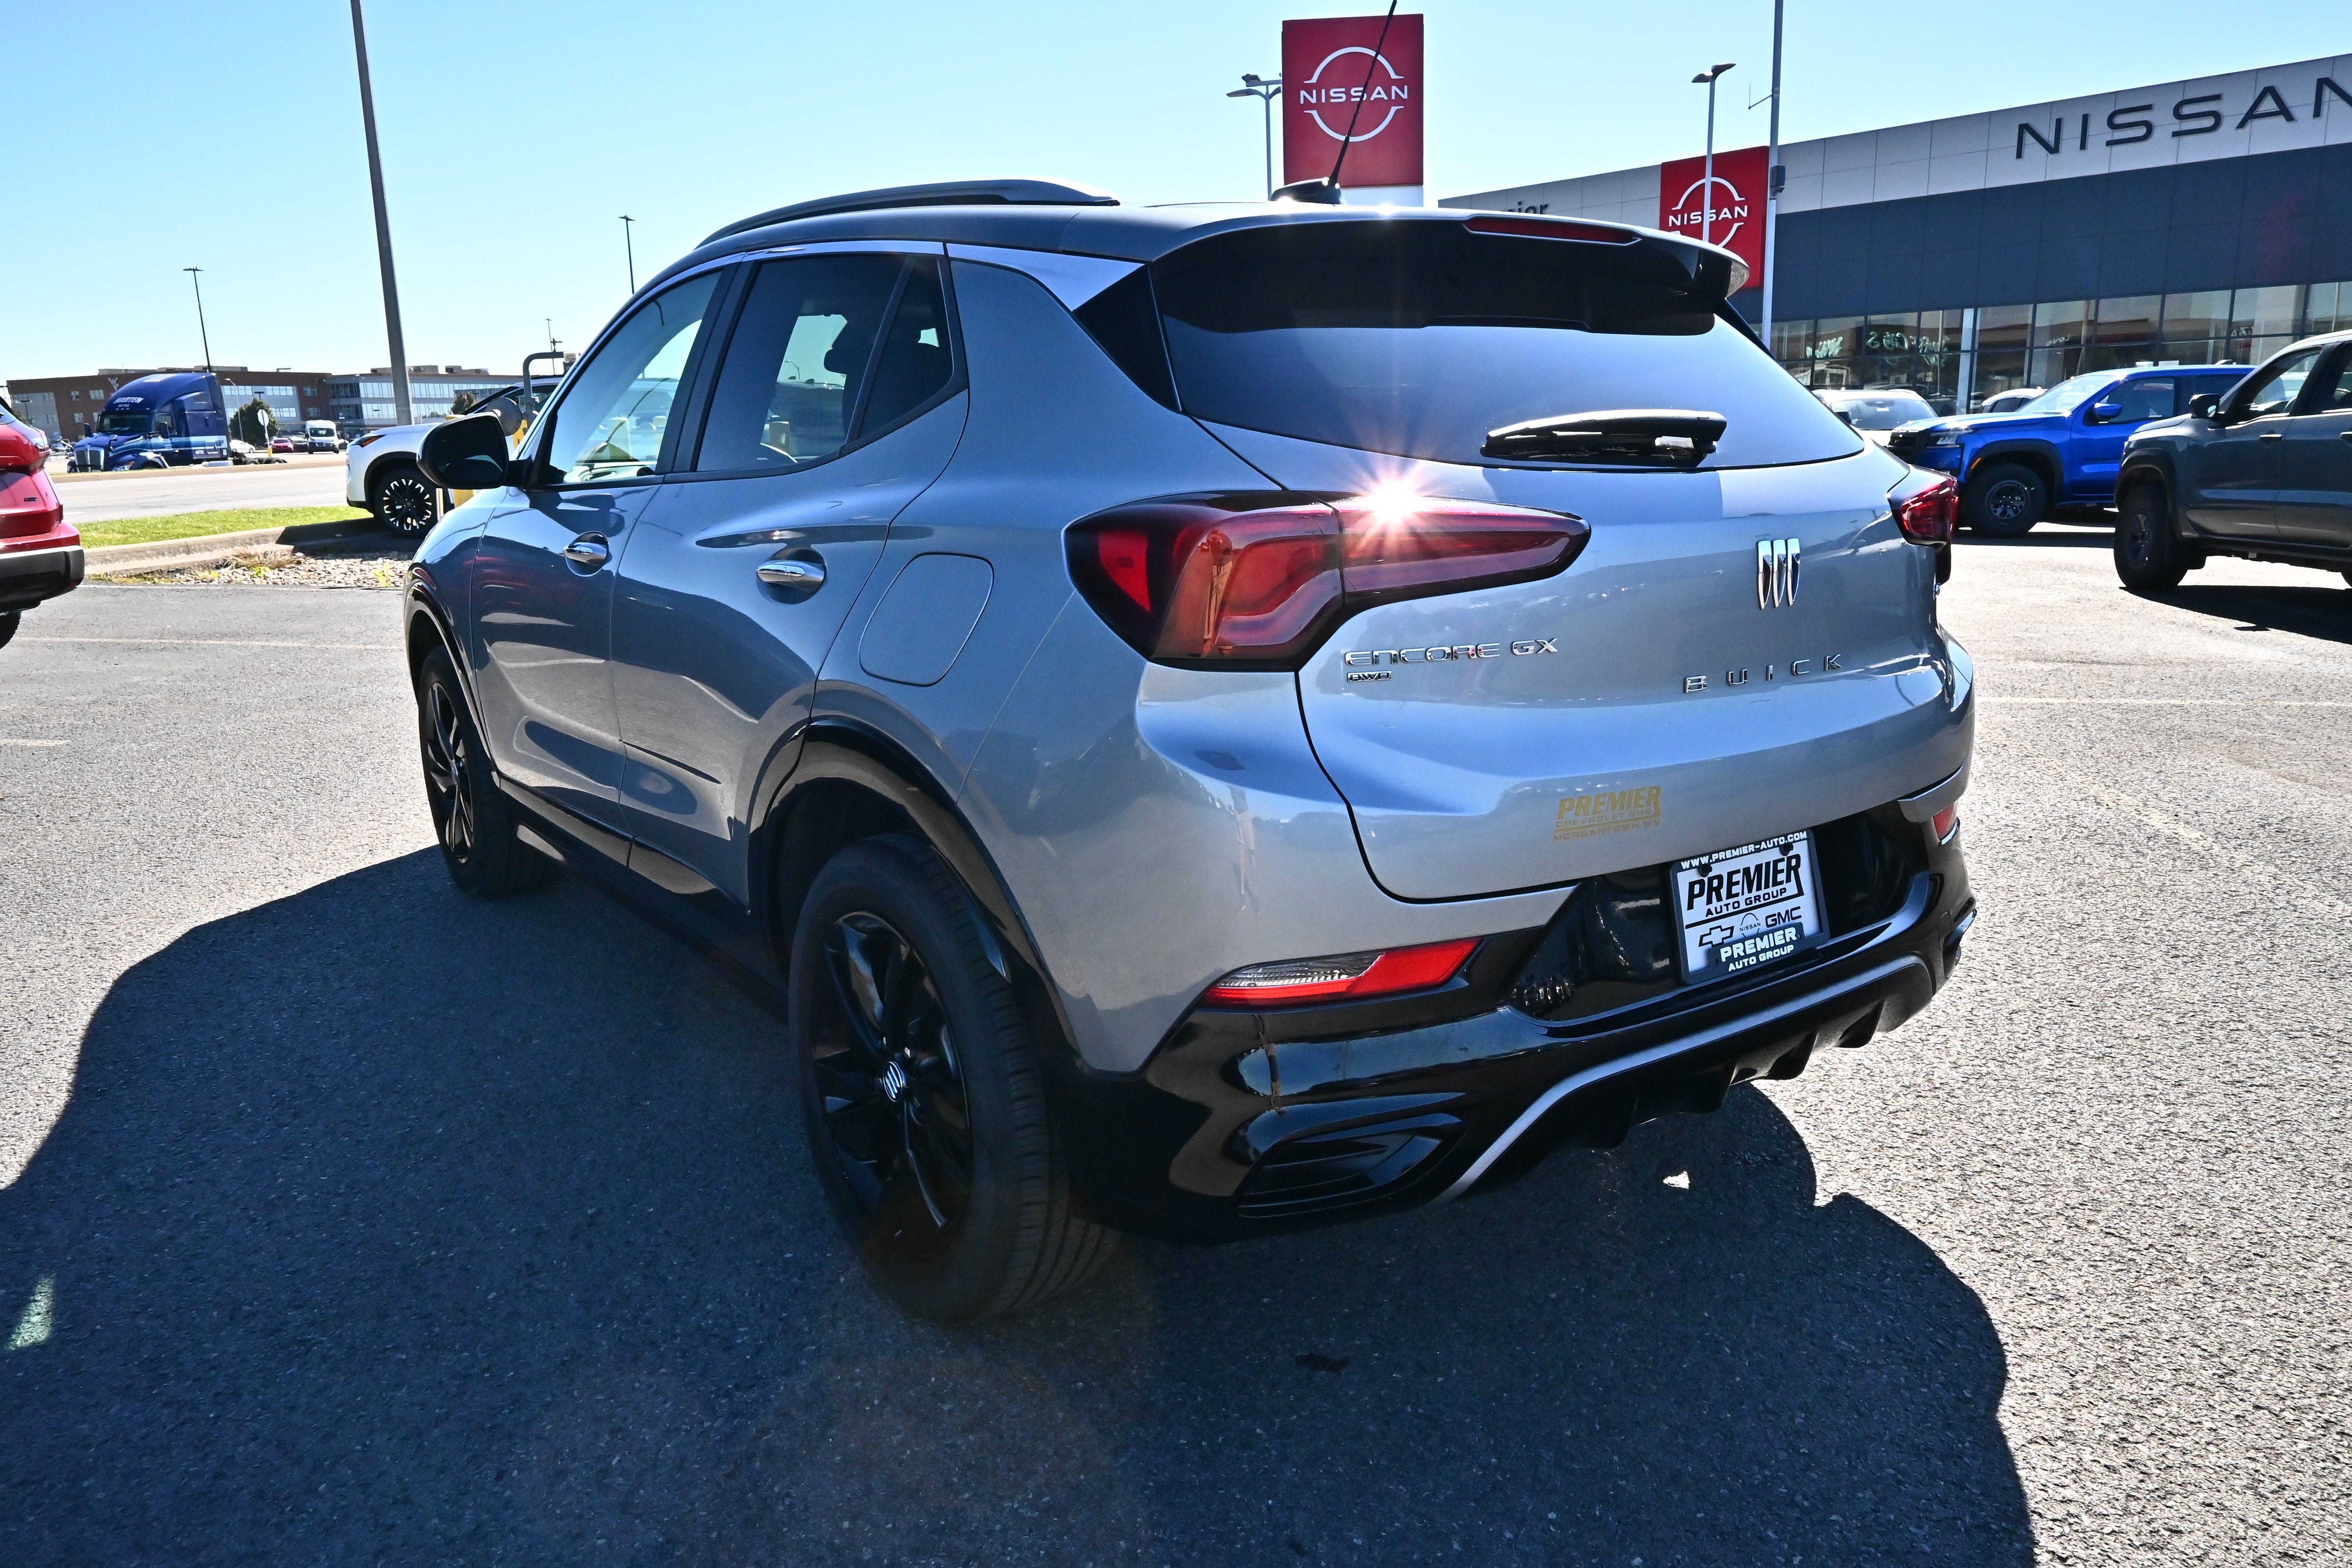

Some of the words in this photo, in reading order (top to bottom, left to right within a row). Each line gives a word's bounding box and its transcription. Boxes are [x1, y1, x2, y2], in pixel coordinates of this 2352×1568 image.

[1300, 85, 1408, 104] NISSAN
[1669, 205, 1748, 227] NISSAN
[1344, 643, 1500, 666] ENCORE
[1511, 638, 1558, 656] GX
[1348, 671, 1391, 683] AWD
[1684, 654, 1842, 693] BUICK
[1557, 786, 1661, 819] PREMIER
[1553, 822, 1639, 841] MORGANTOWN
[1555, 813, 1626, 828] CHEVROLET
[1629, 808, 1652, 817] GMC
[1681, 831, 1808, 869] WWW.PREMIER-AUTO.COM
[1687, 853, 1804, 911] PREMIER
[1705, 900, 1740, 917] AUTO
[1745, 887, 1787, 906] GROUP
[1740, 922, 1761, 932] NISSAN
[1765, 906, 1802, 928] GMC
[1720, 927, 1797, 962] PREMIER
[1728, 957, 1757, 972] AUTO
[1759, 945, 1794, 962] GROUP
